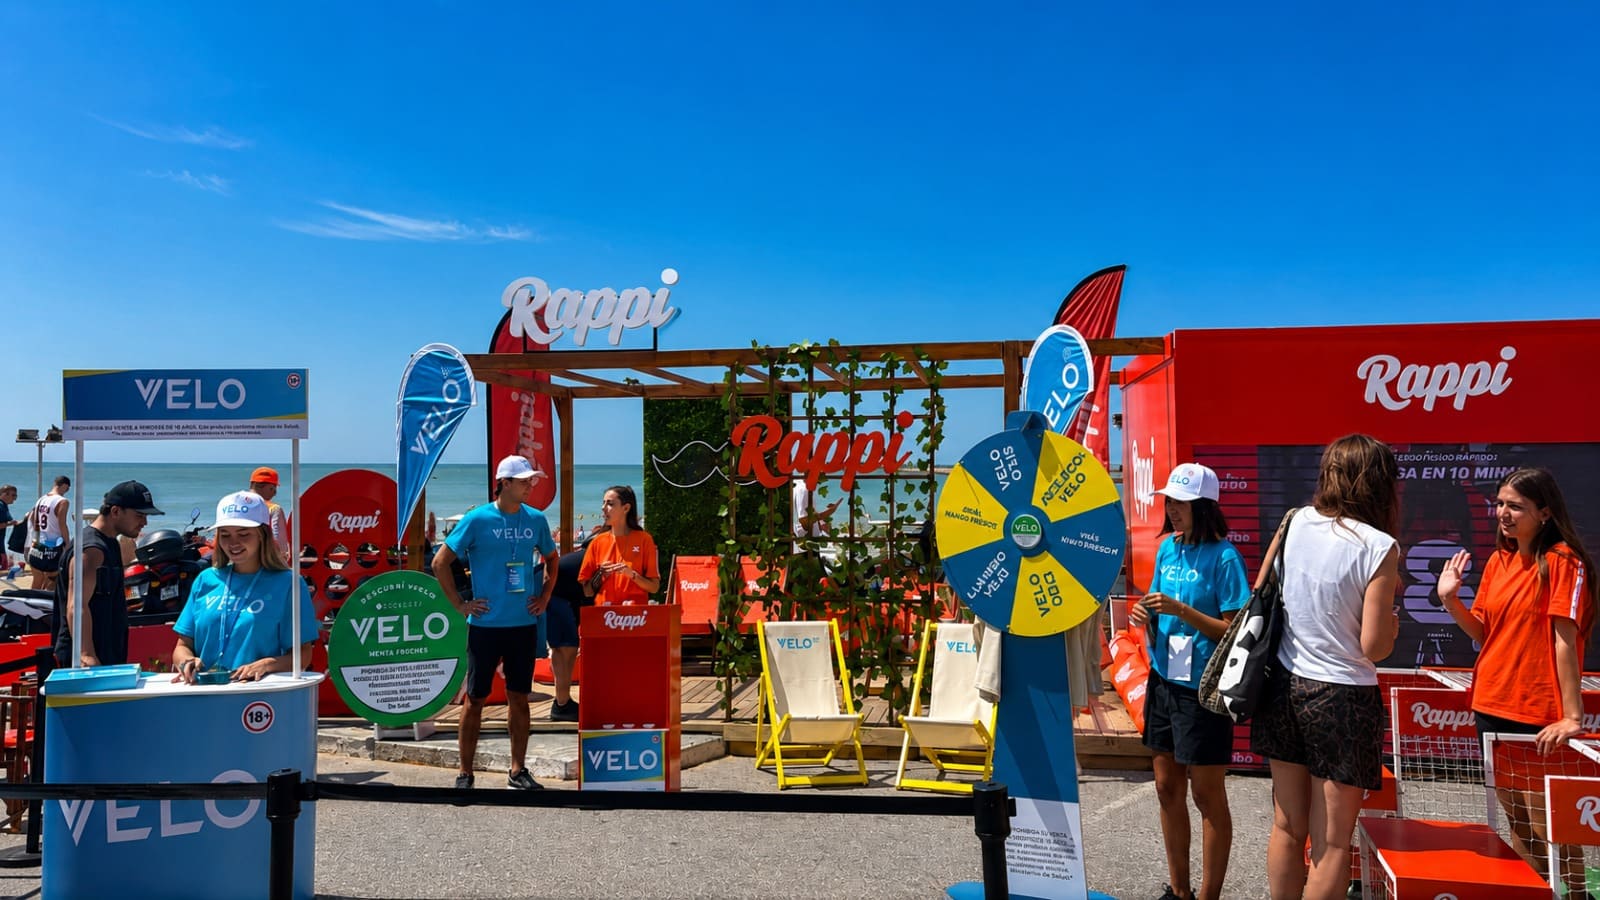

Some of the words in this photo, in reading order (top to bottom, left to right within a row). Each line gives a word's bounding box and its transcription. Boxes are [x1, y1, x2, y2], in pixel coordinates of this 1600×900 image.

[502, 268, 678, 346] Rappi
[1357, 346, 1516, 411] Rappi
[135, 378, 246, 409] VELO
[1043, 363, 1079, 428] ELO
[411, 379, 461, 455] VELO
[731, 411, 913, 491] Rappi
[990, 449, 1010, 491] VELO
[1170, 474, 1190, 485] ELO
[1422, 467, 1446, 479] EN
[1450, 467, 1469, 479] 10
[222, 504, 249, 514] VELO
[328, 509, 381, 533] Rappi
[1015, 524, 1038, 532] VELO
[492, 528, 534, 539] VELO
[1160, 565, 1198, 582] VELO
[206, 594, 264, 613] VELO
[1029, 573, 1051, 618] VELO
[350, 612, 449, 645] VELO
[604, 610, 648, 631] Rappi
[777, 638, 812, 649] VELO
[247, 711, 271, 724] 18+
[587, 749, 658, 771] VELO
[58, 770, 261, 847] VELO
